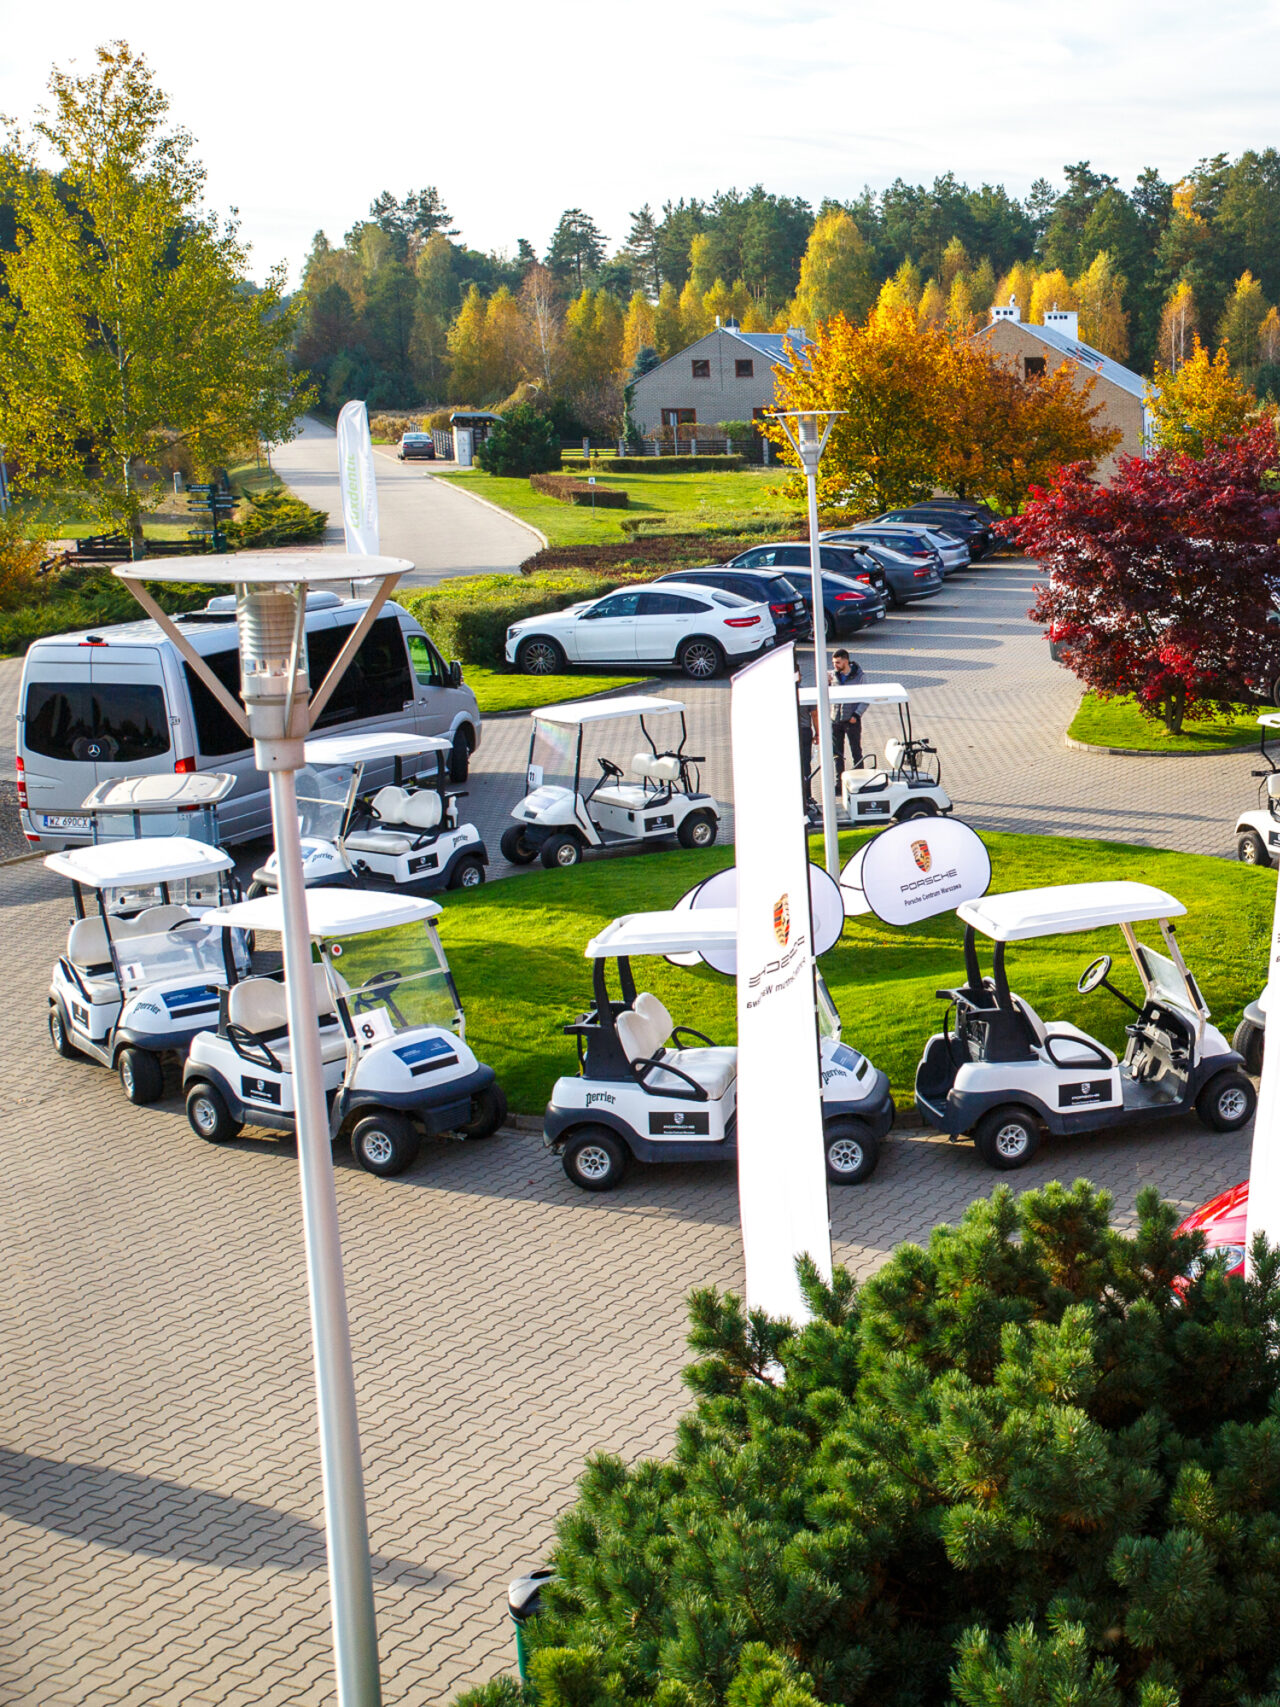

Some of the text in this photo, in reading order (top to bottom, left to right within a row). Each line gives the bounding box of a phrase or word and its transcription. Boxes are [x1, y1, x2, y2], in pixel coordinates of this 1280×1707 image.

[50, 817, 88, 828] WZ 690CX
[900, 869, 958, 893] PORSCHE
[904, 883, 962, 906] Porsche Centrum Warszawa
[127, 965, 136, 979] 1
[133, 1002, 161, 1014] perrier
[362, 1024, 374, 1039] 8
[586, 1091, 616, 1107] perrier
